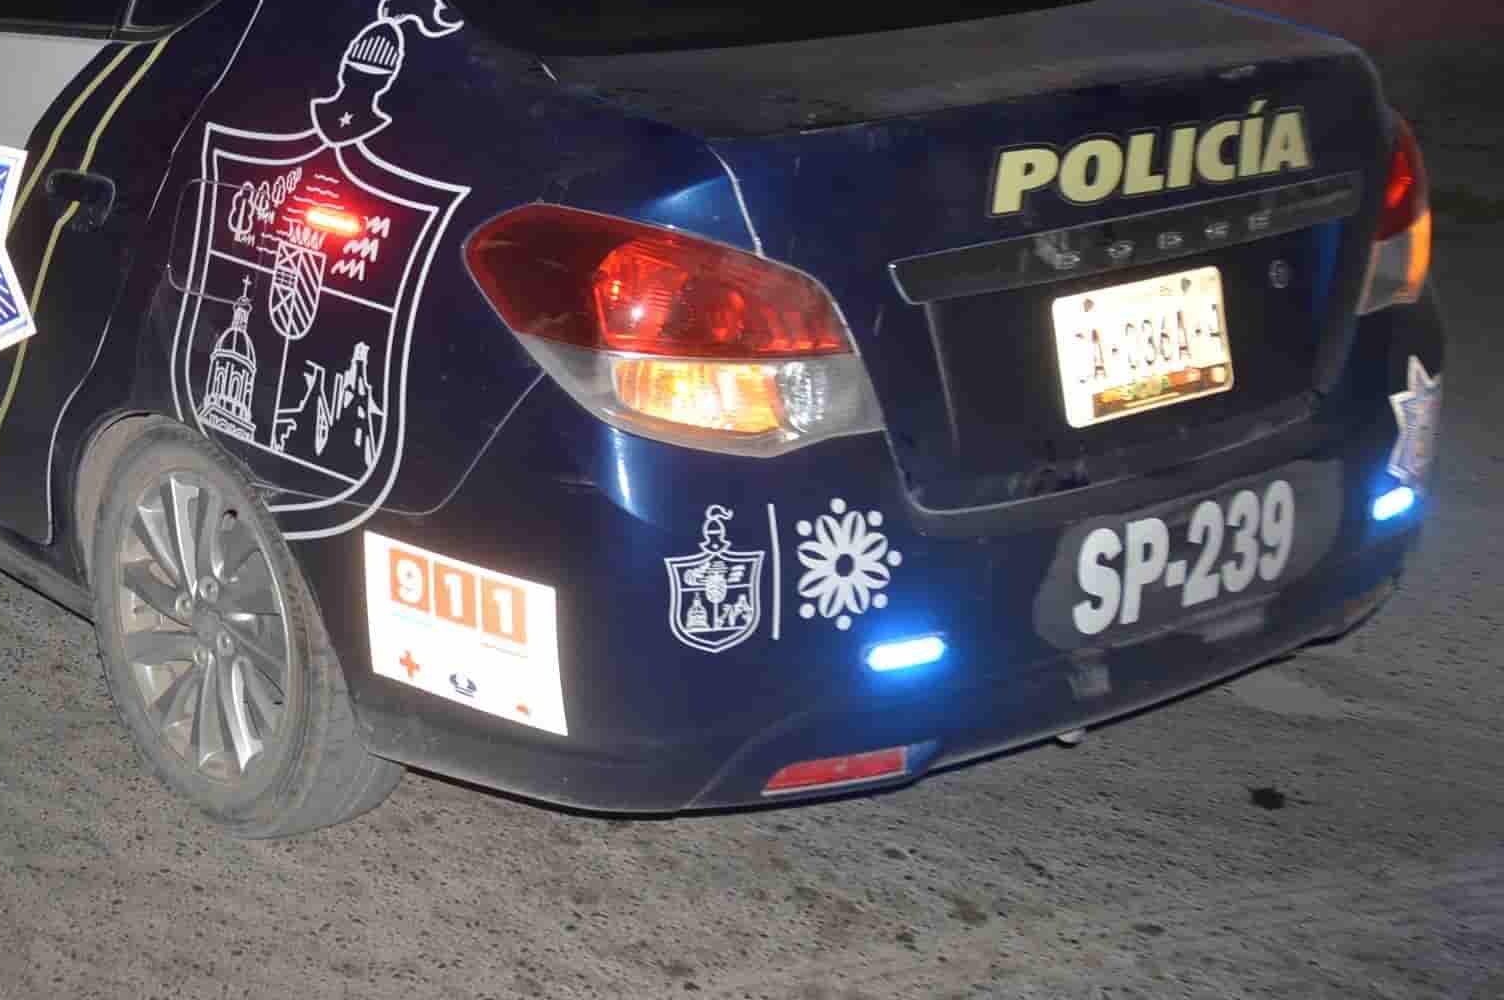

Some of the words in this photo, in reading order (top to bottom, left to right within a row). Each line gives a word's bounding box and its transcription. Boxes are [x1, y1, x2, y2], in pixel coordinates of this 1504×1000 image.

[991, 99, 1311, 215] POLICÍA
[394, 556, 515, 637] 911
[1072, 479, 1295, 635] SP-239
